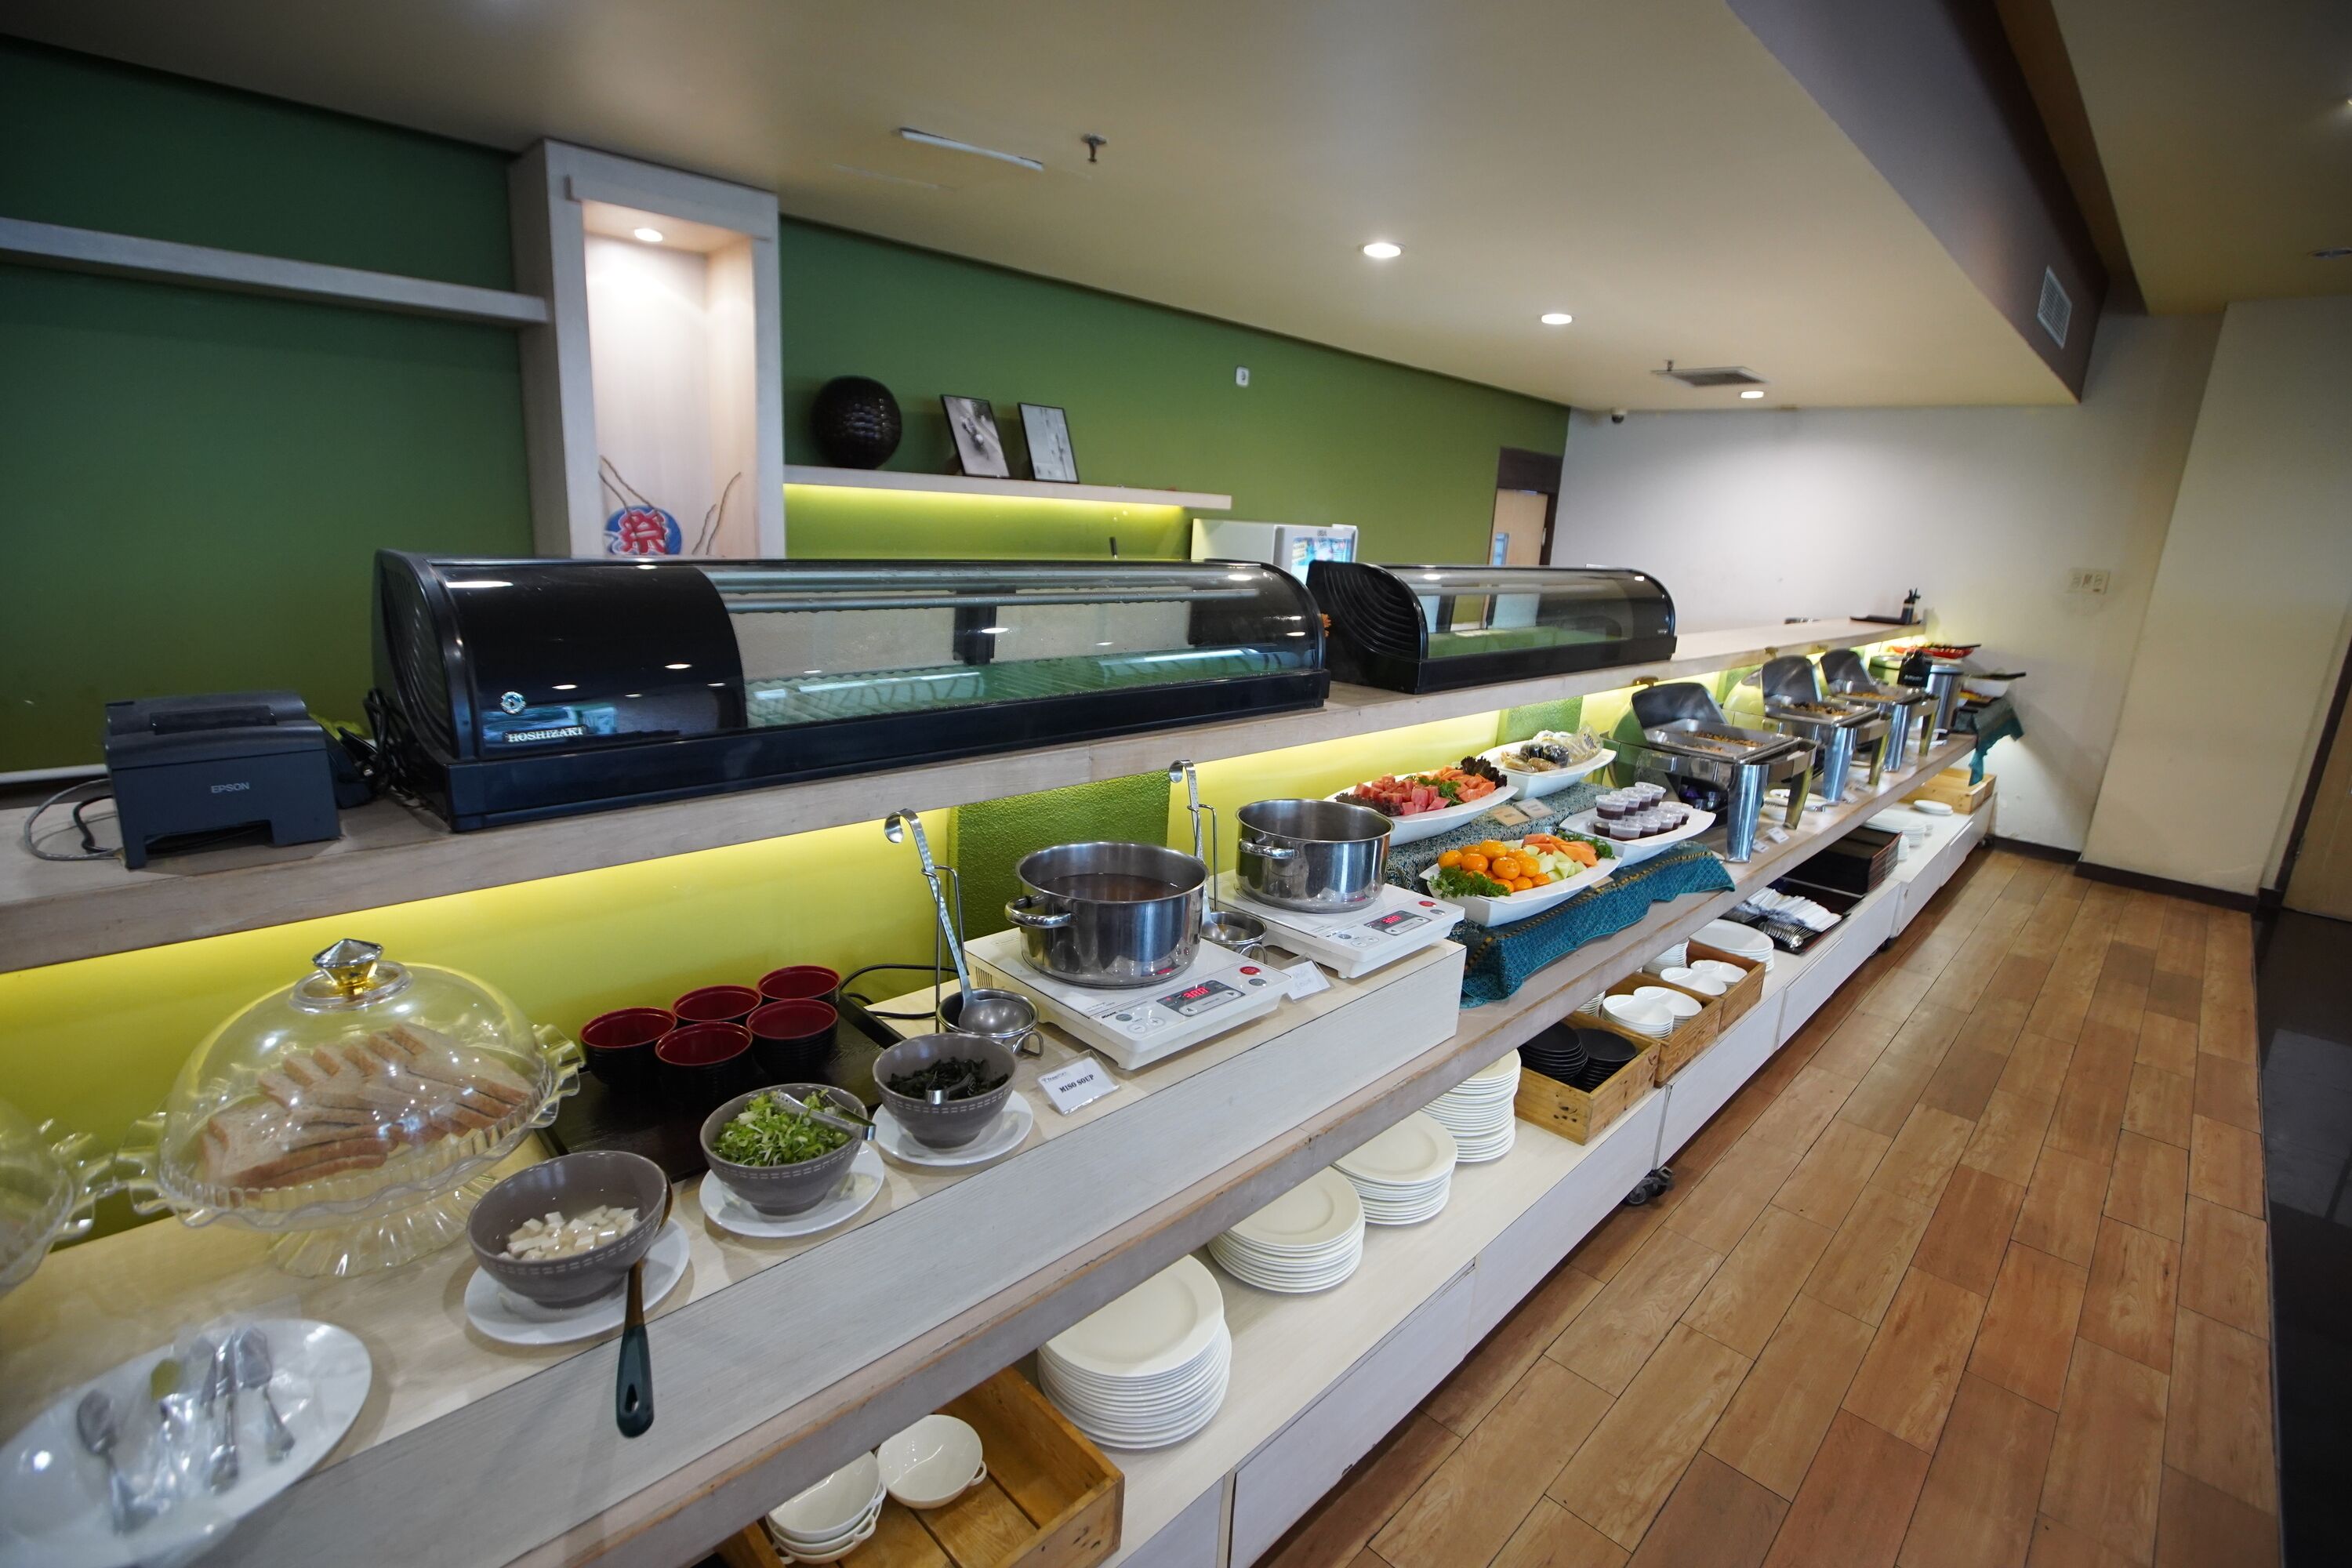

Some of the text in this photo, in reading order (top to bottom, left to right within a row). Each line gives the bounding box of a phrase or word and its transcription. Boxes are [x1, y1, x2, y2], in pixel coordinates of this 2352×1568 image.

[507, 726, 584, 743] HOSHIZAKI
[210, 782, 250, 793] EPSON
[1058, 1082, 1077, 1094] MISO
[1076, 1073, 1094, 1086] SOUP
